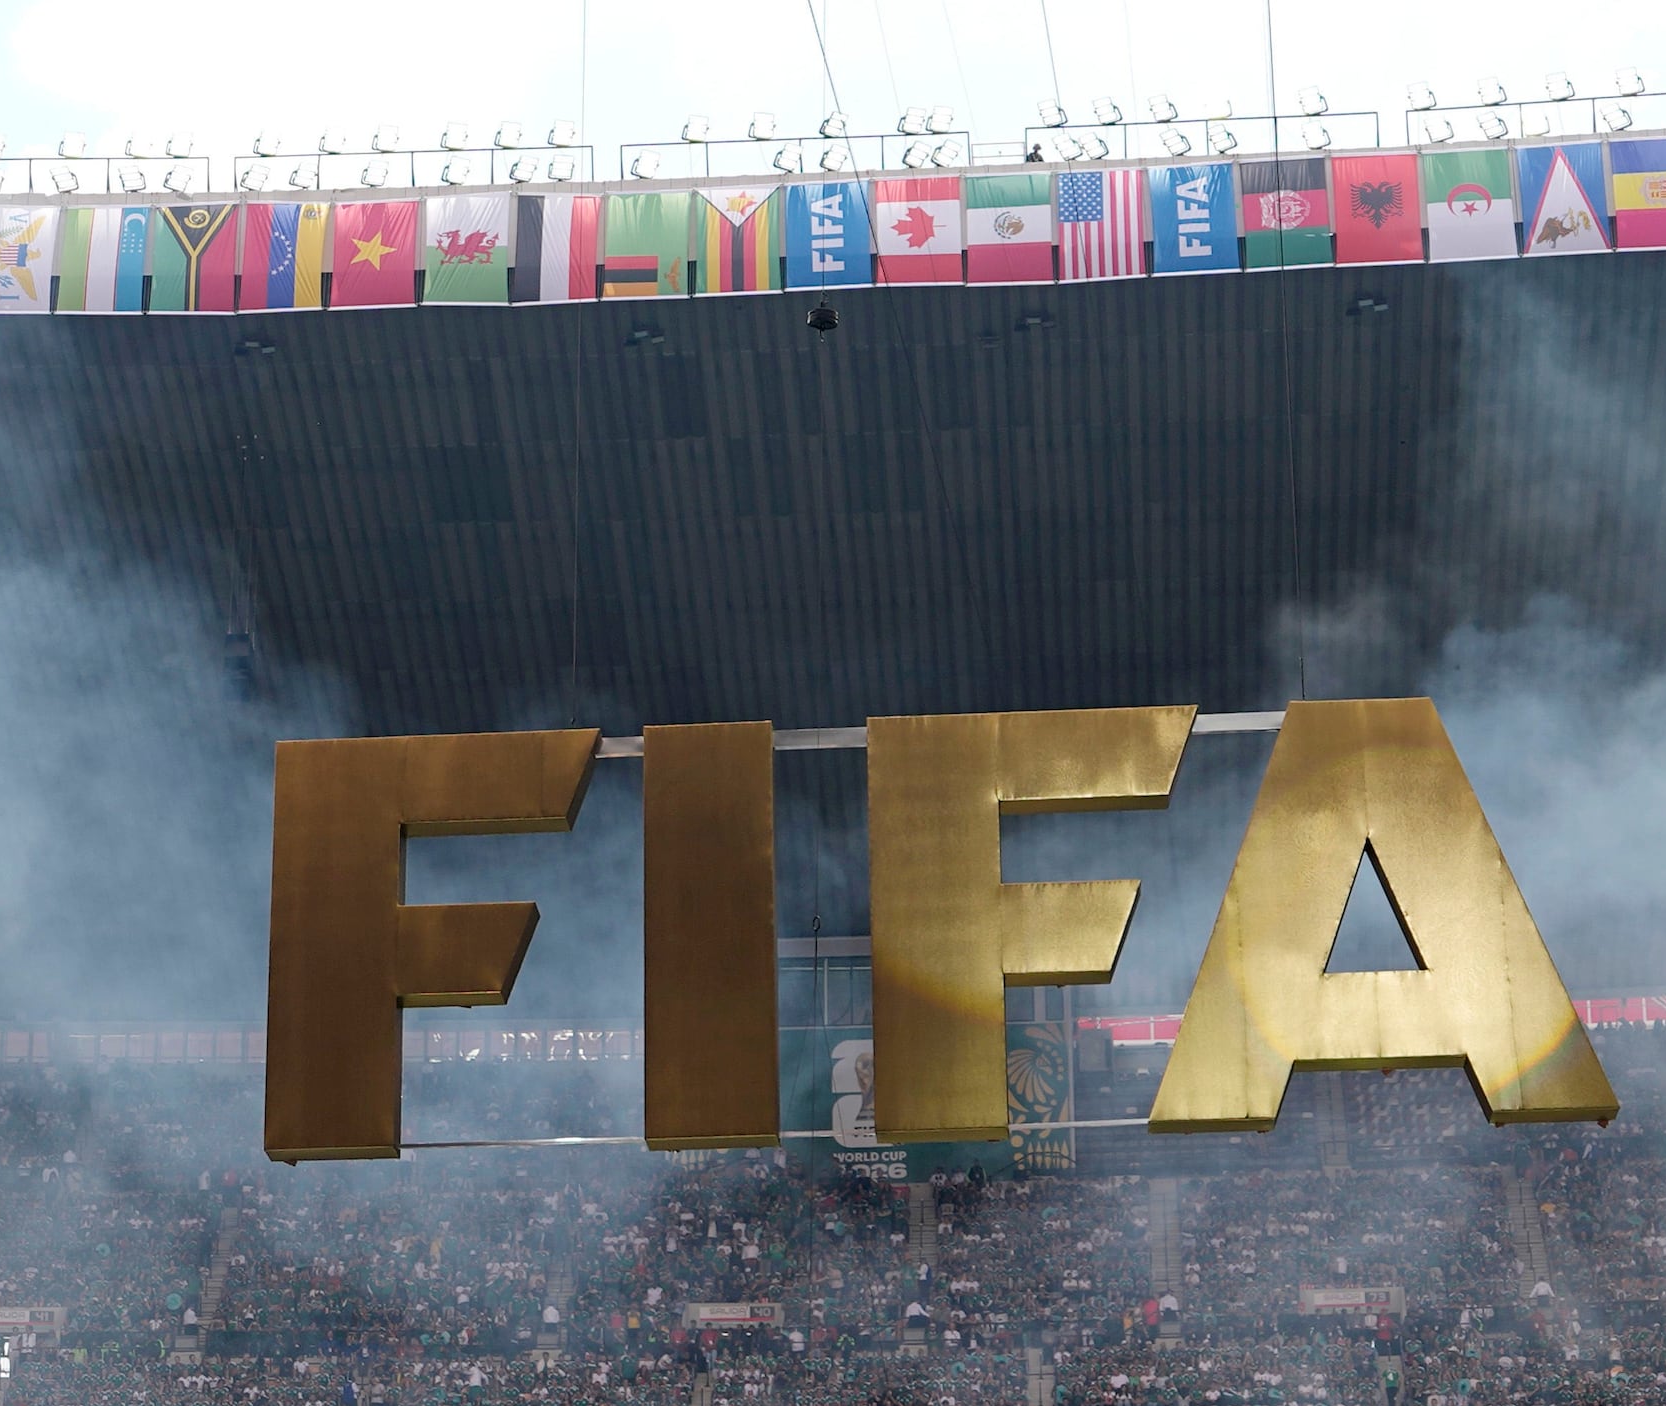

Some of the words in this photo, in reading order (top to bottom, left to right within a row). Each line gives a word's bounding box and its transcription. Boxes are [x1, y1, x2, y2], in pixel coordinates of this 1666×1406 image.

[1178, 176, 1212, 258] FIFA
[811, 194, 845, 273] FIFA
[263, 697, 1620, 1164] FIFA
[833, 1151, 880, 1162] WORLD
[882, 1150, 907, 1161] CUP
[839, 1163, 908, 1180] 026
[34, 1311, 49, 1322] 41
[710, 1306, 747, 1317] SALIDA
[753, 1306, 771, 1317] 40
